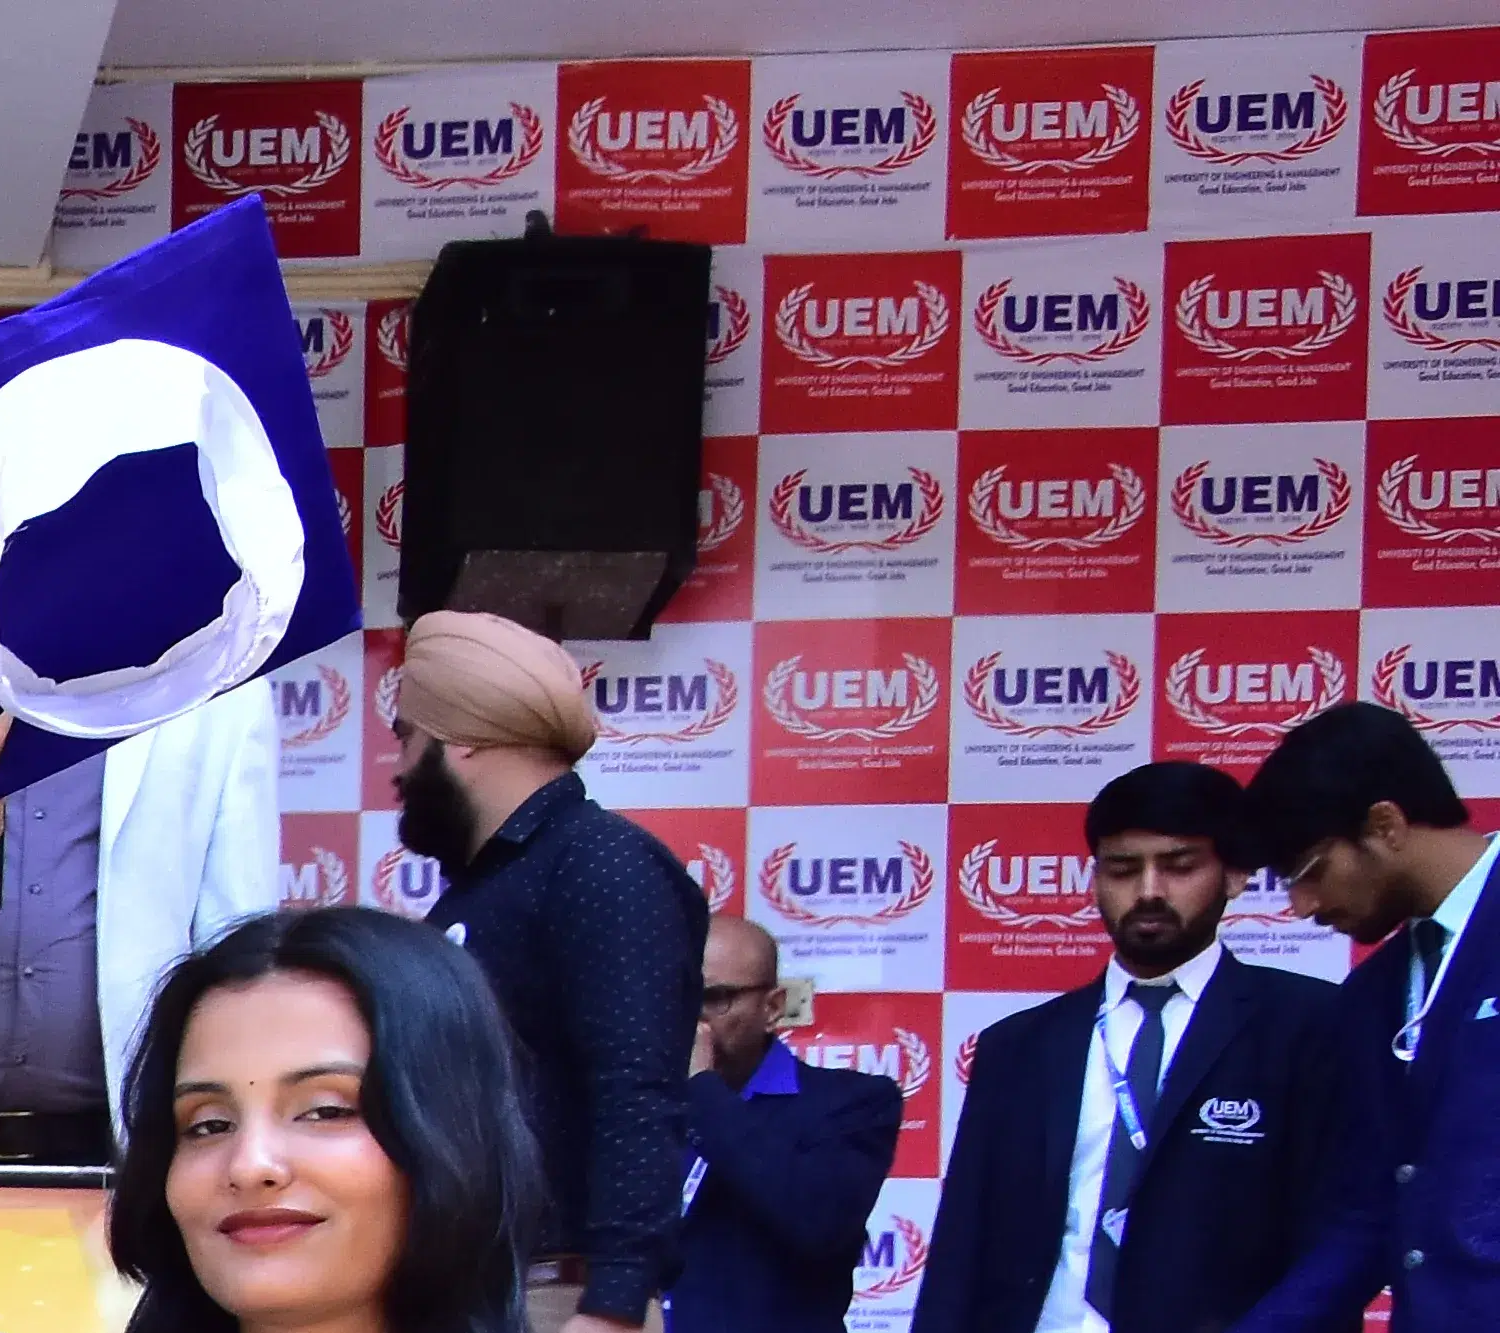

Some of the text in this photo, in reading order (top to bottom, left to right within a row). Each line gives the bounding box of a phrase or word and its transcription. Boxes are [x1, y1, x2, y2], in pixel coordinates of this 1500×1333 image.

[598, 112, 708, 150] UEM
[793, 108, 905, 146] UEM
[992, 101, 1107, 141] UEM
[1197, 92, 1315, 133] UEM
[67, 132, 131, 170] EM
[212, 127, 320, 166] UEM
[404, 119, 512, 159] UEM
[805, 298, 918, 337] UEM
[1004, 294, 1118, 333] UEM
[1206, 288, 1324, 328] UEM
[1414, 280, 1500, 321] UE
[799, 484, 912, 522] UEM
[999, 479, 1114, 519] UEM
[1202, 475, 1318, 514] UEM
[596, 676, 707, 713] UEM
[793, 670, 906, 710] UEM
[995, 667, 1108, 705] UEM
[1196, 664, 1313, 703] UEM
[790, 858, 902, 895] UEM
[988, 854, 1096, 894] UEM
[1213, 1101, 1249, 1115] UEM
